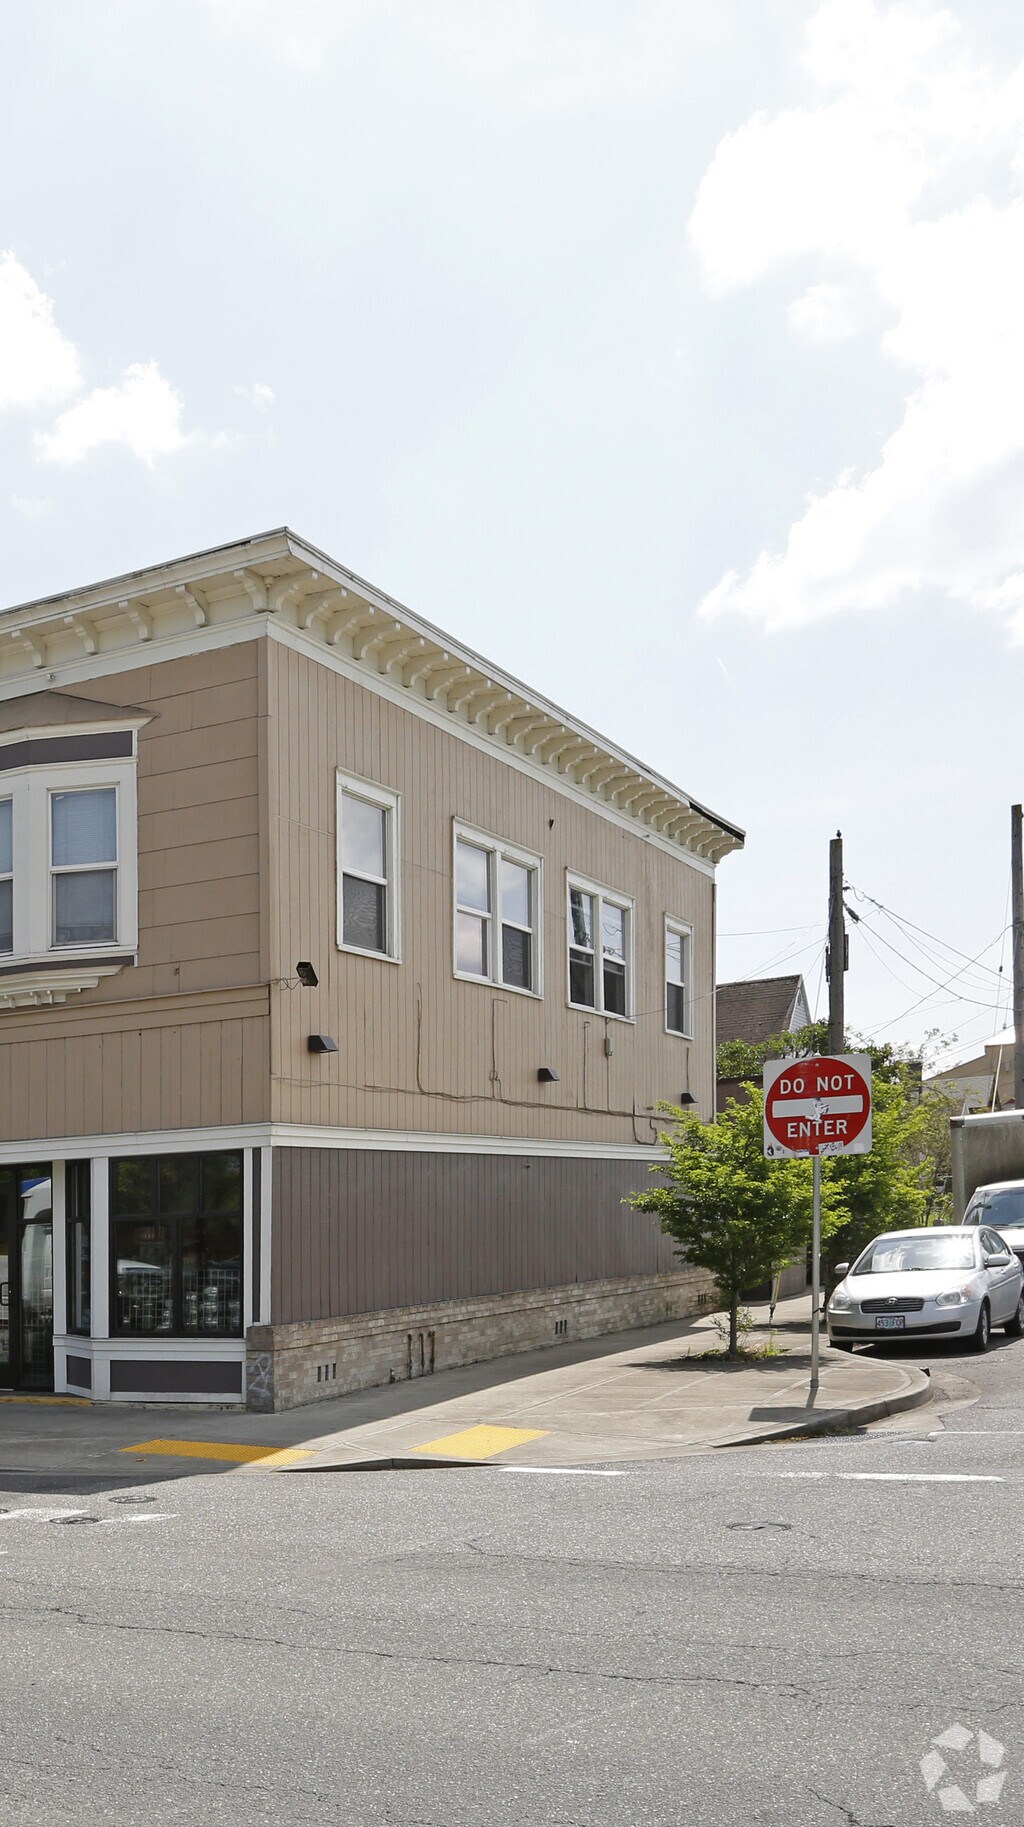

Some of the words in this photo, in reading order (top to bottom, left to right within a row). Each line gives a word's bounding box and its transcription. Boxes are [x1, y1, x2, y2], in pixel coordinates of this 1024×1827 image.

[780, 1078, 805, 1095] DO
[817, 1074, 855, 1092] NOT
[787, 1119, 848, 1138] ENTER
